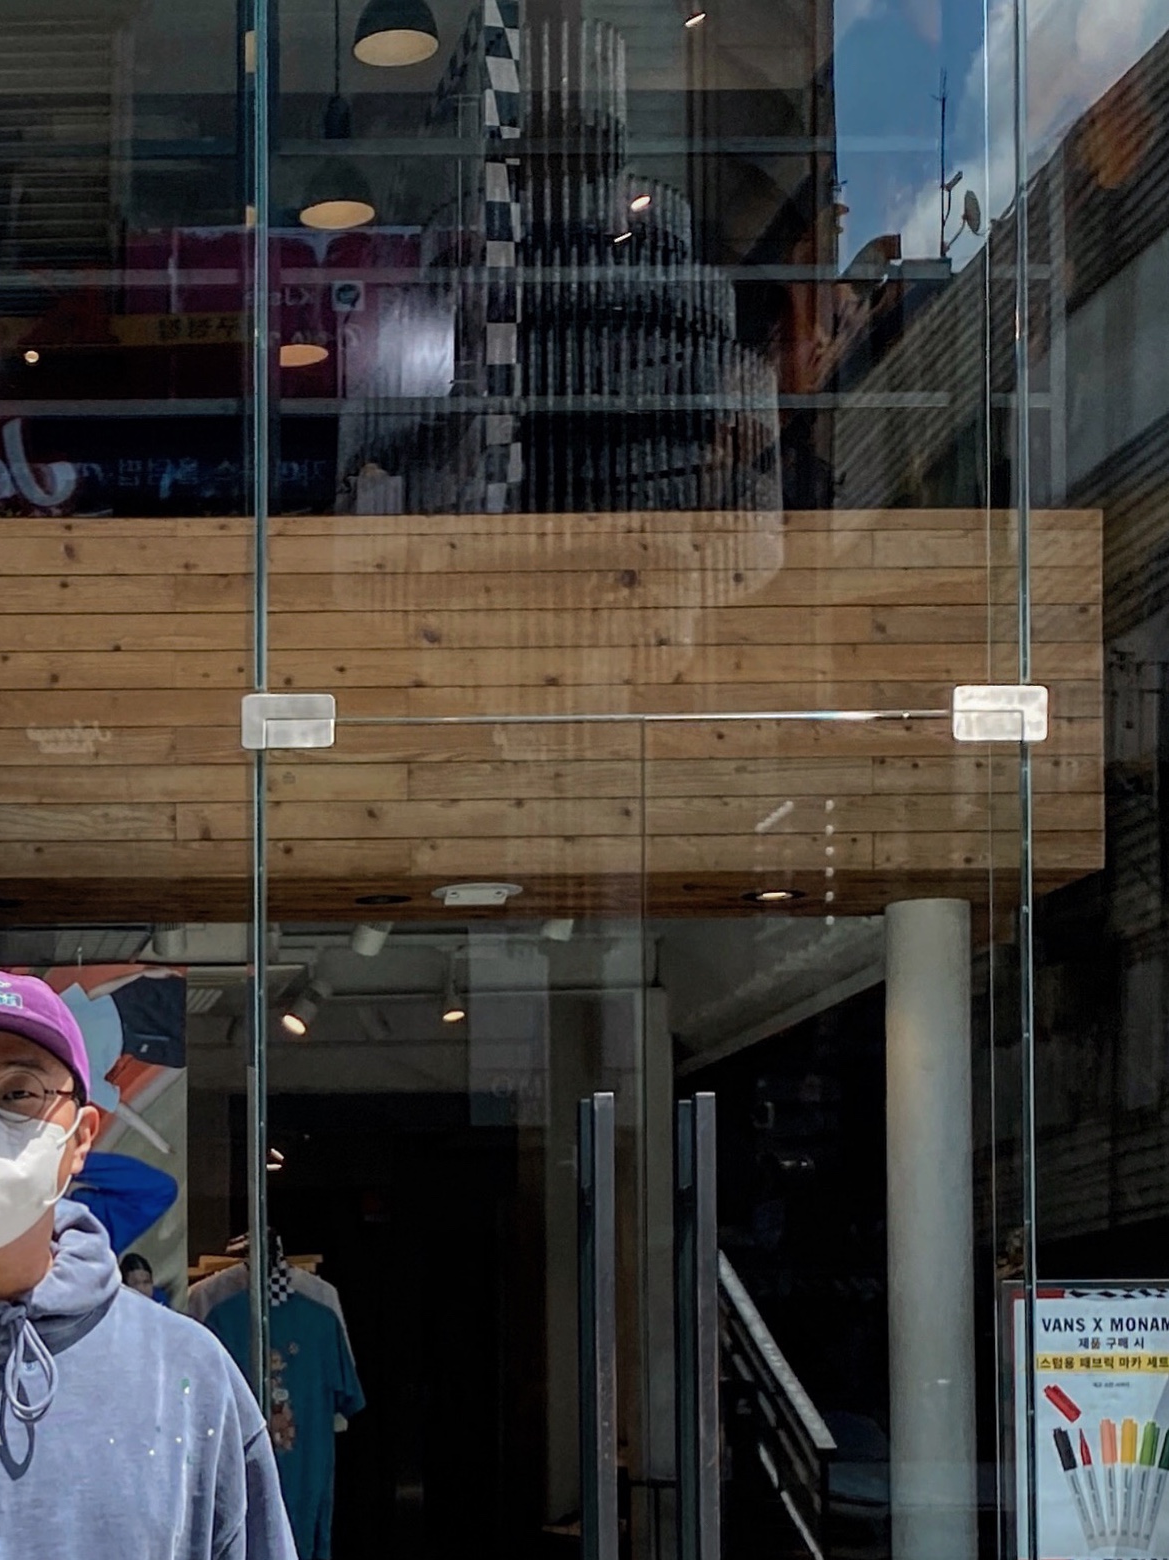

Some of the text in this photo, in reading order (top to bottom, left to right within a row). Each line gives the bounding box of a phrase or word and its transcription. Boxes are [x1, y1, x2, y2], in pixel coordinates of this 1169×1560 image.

[1041, 1317, 1086, 1333] VANS
[1092, 1317, 1103, 1332] X
[1078, 1336, 1145, 1350] 제품 구매 시
[1079, 1356, 1115, 1369] 패브릭
[1118, 1356, 1142, 1369] 마카
